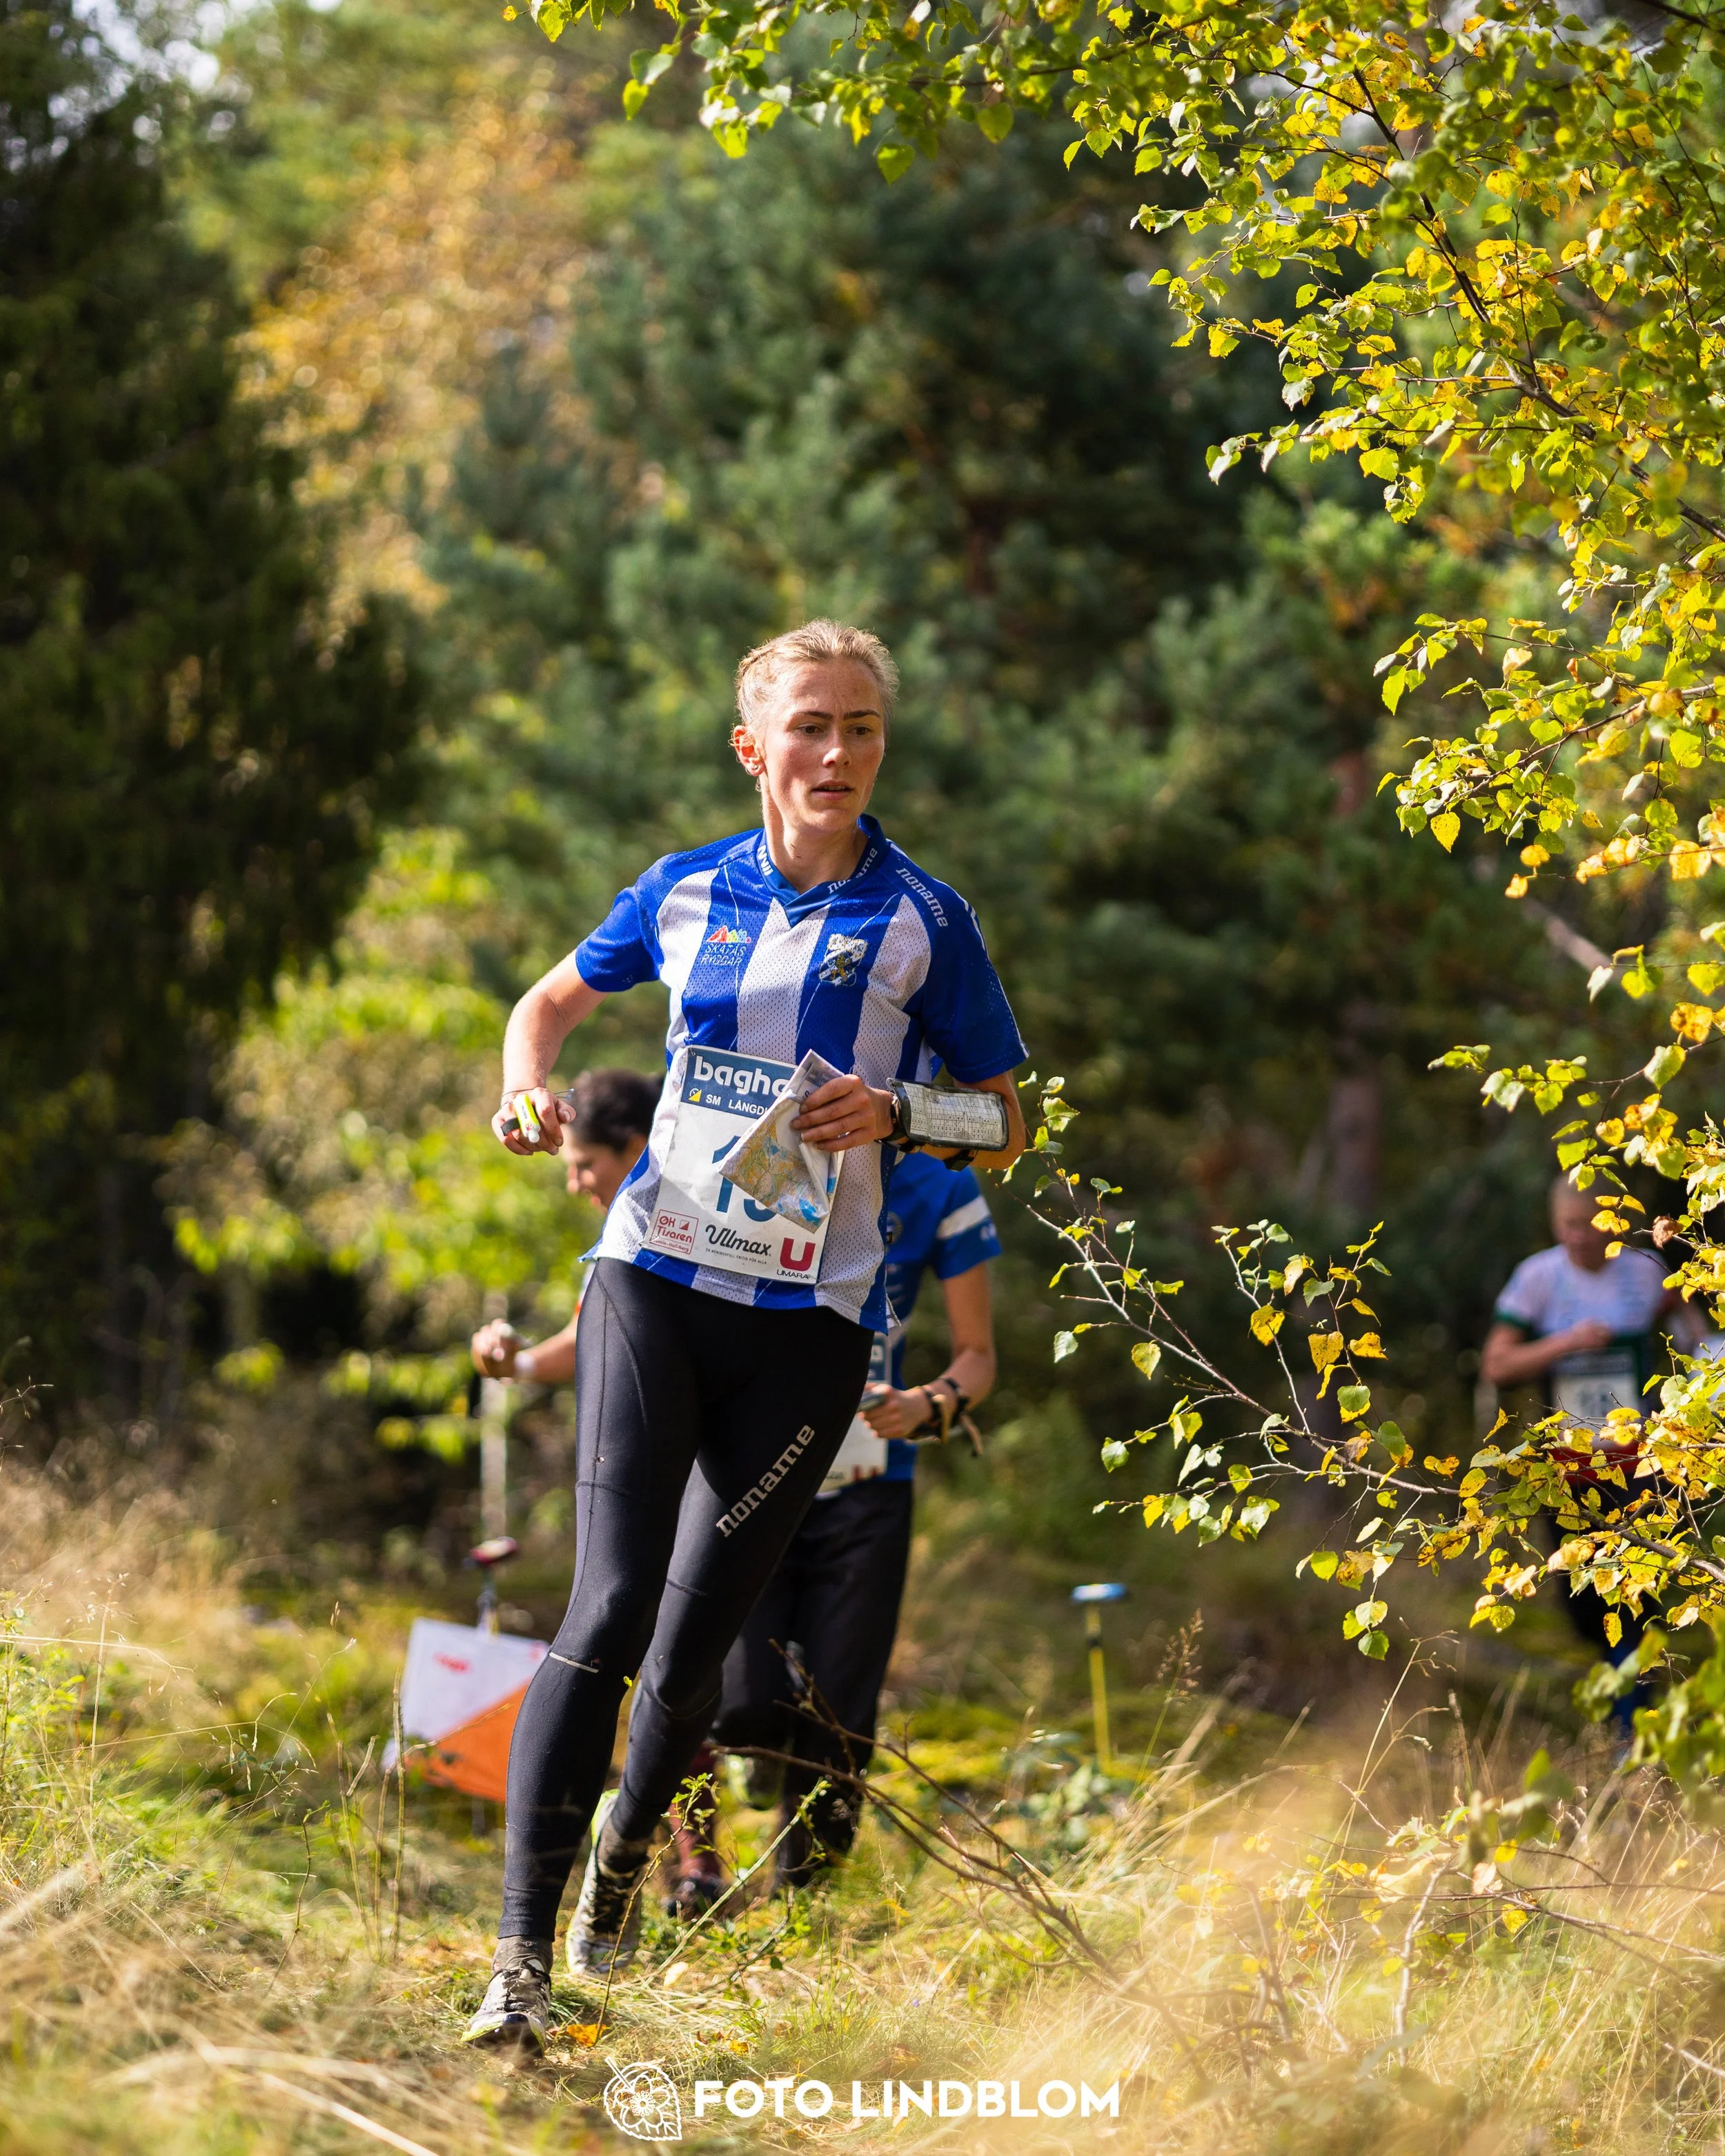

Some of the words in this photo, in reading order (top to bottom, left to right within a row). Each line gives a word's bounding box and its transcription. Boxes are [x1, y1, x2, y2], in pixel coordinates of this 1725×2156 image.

[827, 847, 878, 894] noame
[895, 867, 949, 927] noname
[705, 1094, 722, 1106] SM
[657, 1225, 693, 1243] Tisaren
[705, 1224, 771, 1256] Ullmax
[780, 1237, 816, 1272] U
[776, 1269, 809, 1280] UMARA
[716, 1425, 816, 1538] noname
